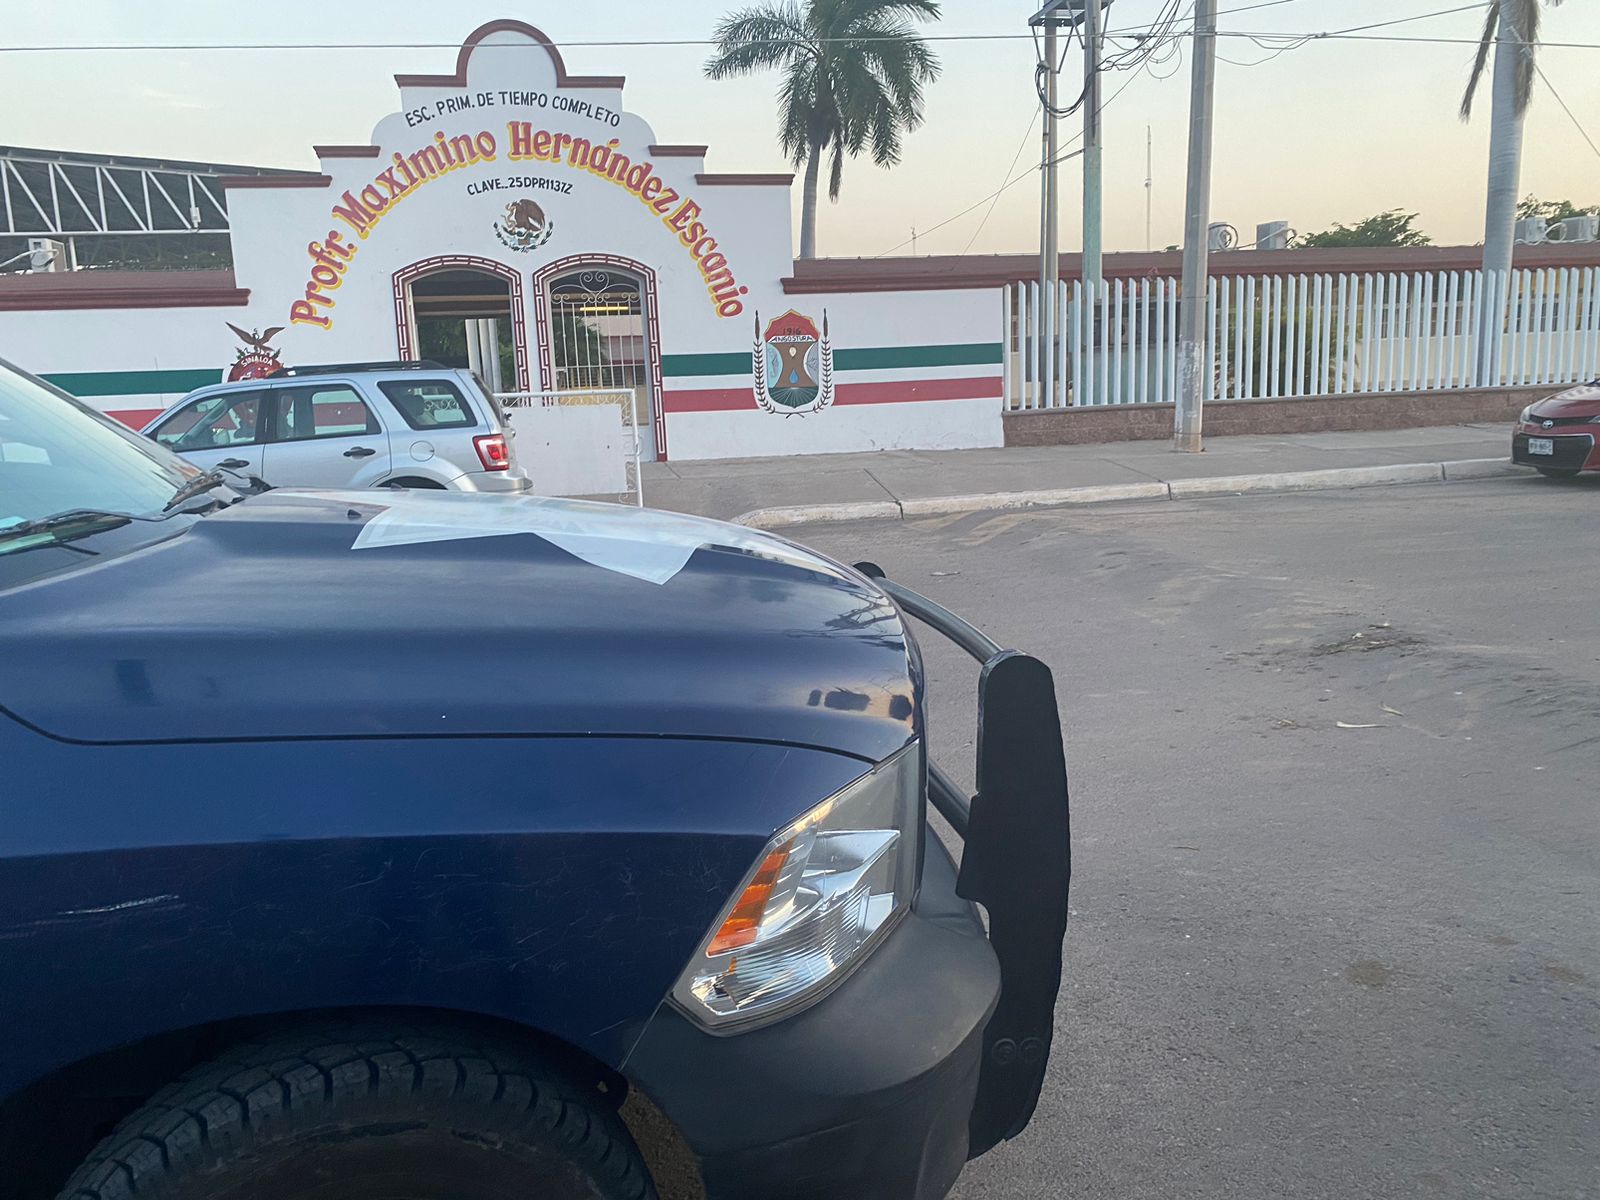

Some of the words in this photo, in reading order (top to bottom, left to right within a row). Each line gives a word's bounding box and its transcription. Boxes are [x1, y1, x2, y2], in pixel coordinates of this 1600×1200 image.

[405, 107, 435, 128] ESC.
[436, 95, 475, 116] PRIM.
[477, 92, 494, 106] DE
[498, 91, 548, 107] TIEMPO
[552, 96, 621, 127] COMPLETO
[290, 230, 357, 331] Profr.
[332, 130, 496, 240] Maximino
[507, 120, 680, 216] Hernández
[662, 197, 748, 318] Escanio
[241, 355, 273, 367] SINALOA
